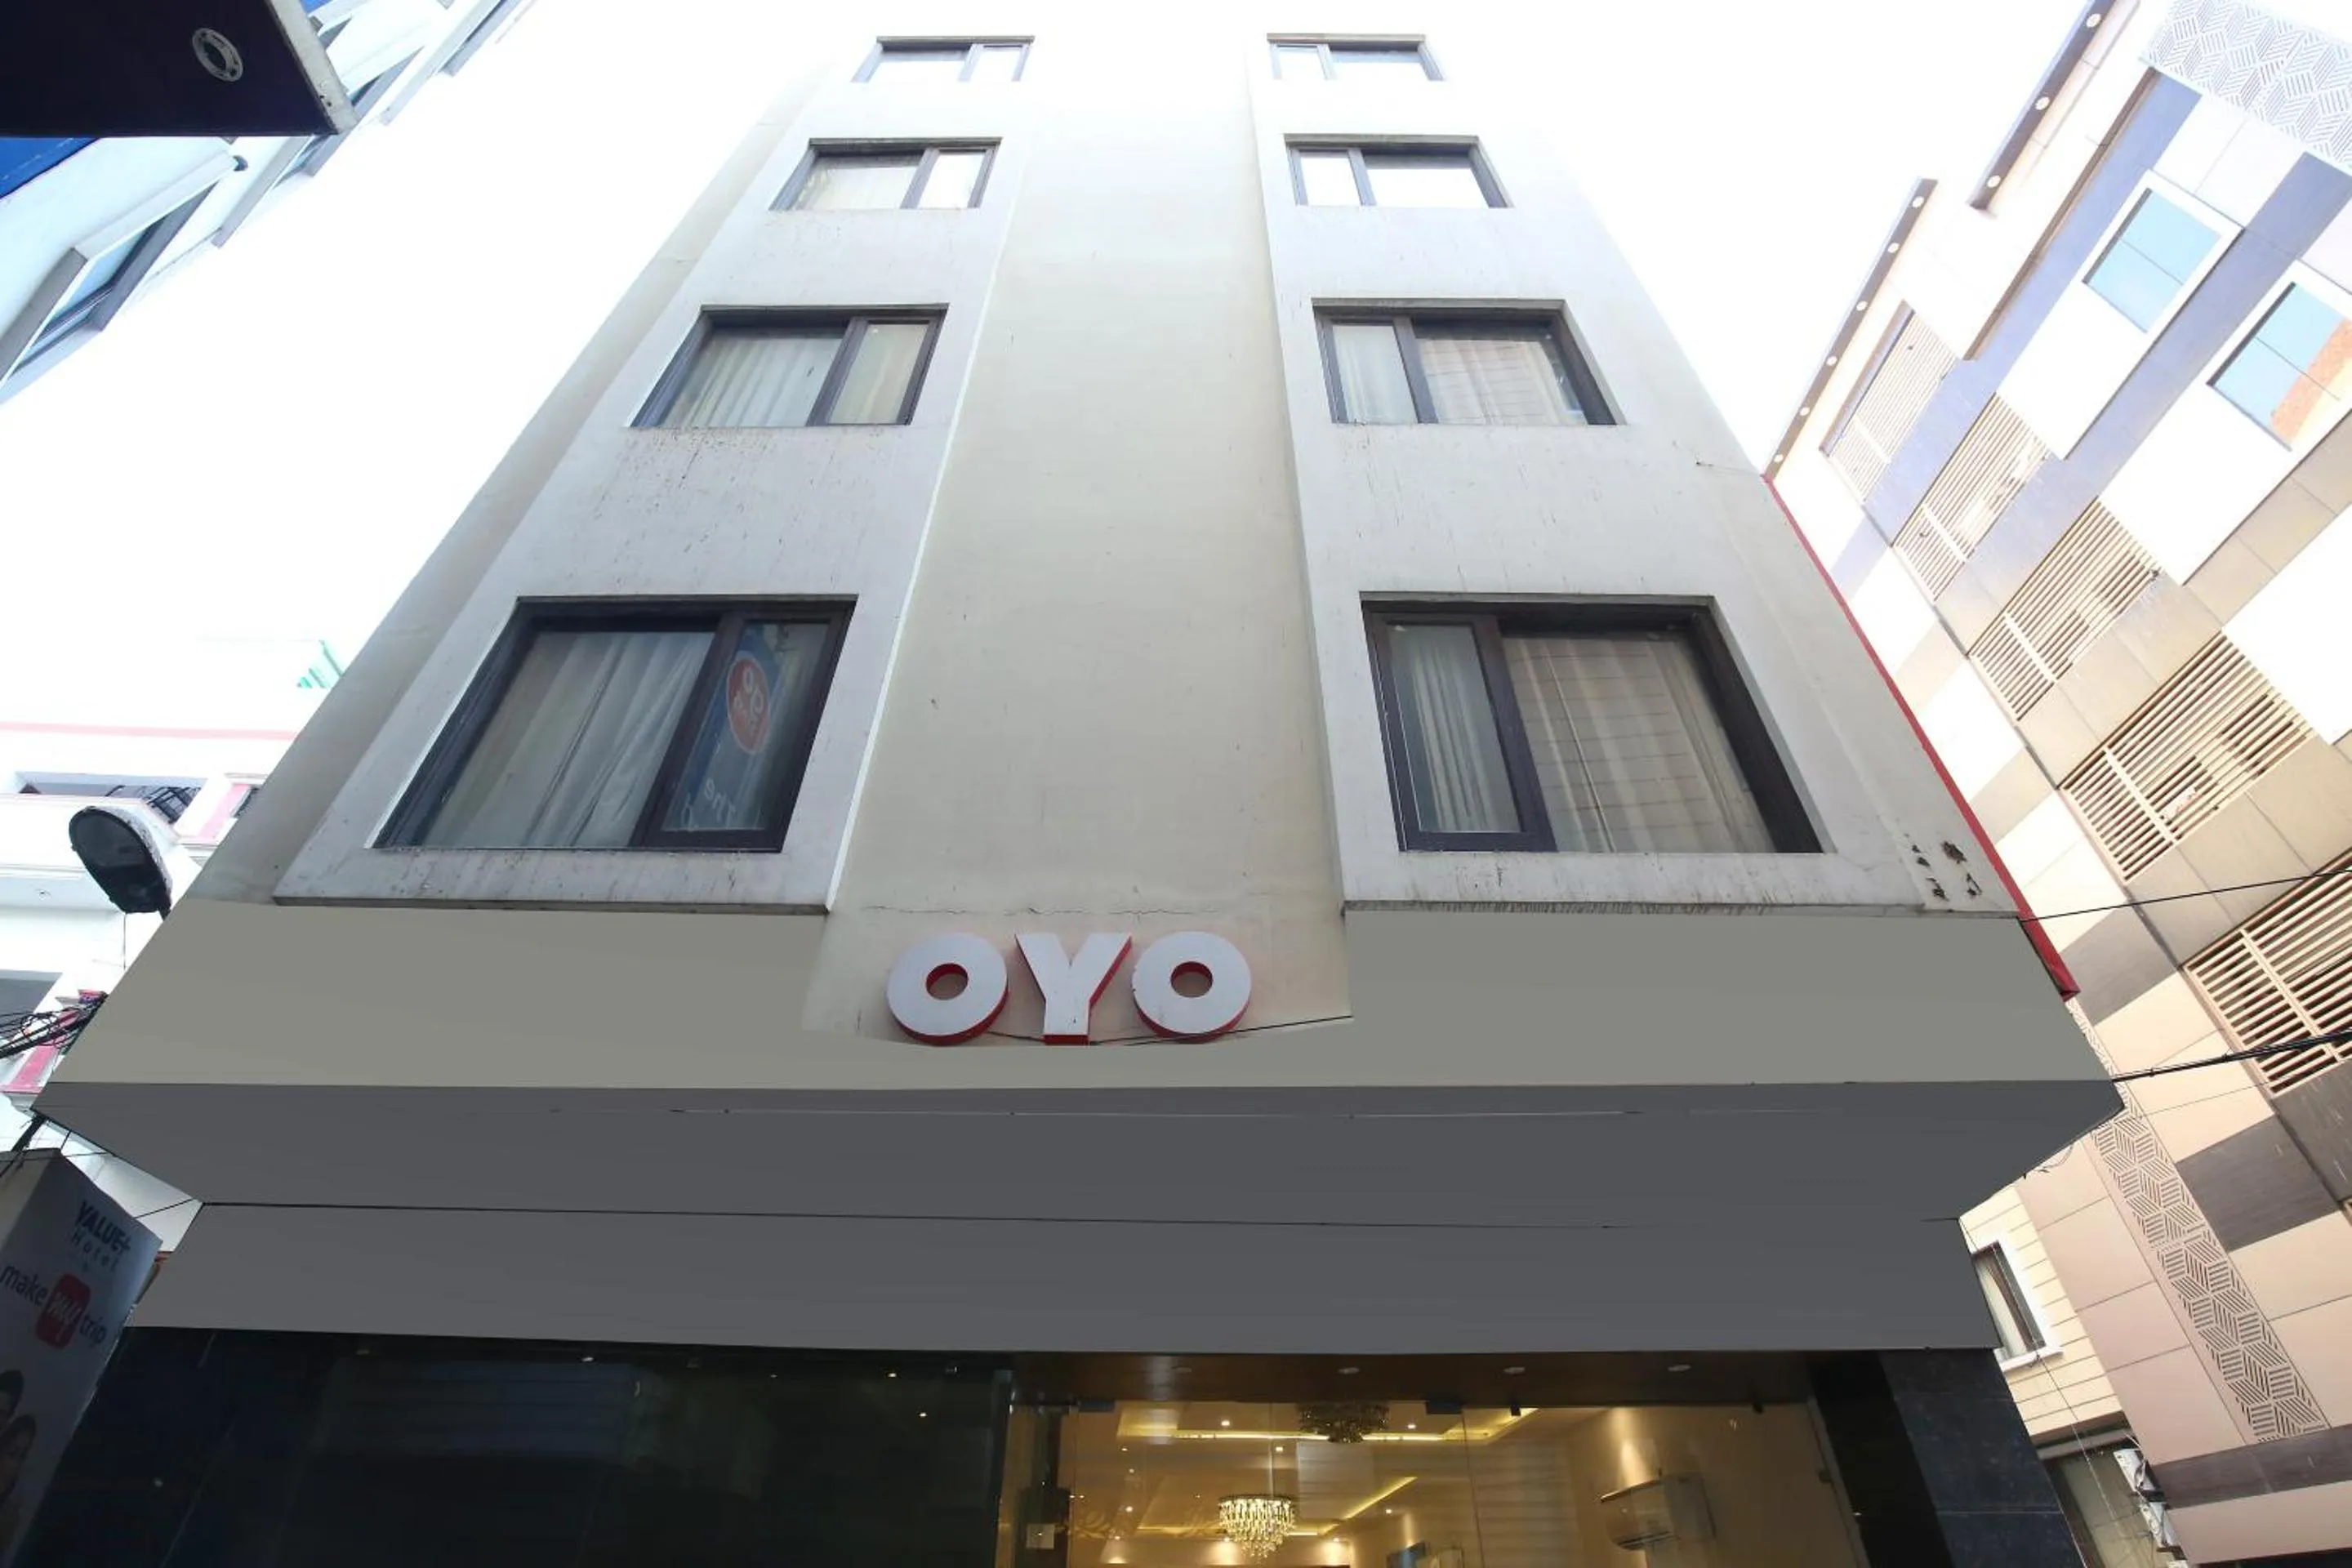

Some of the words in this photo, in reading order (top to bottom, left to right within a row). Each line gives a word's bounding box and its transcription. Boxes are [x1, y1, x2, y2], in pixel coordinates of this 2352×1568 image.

[887, 931, 1252, 1046] OYO
[71, 1230, 118, 1272] Hotel
[0, 1265, 47, 1306] make
[79, 1313, 108, 1348] trip
